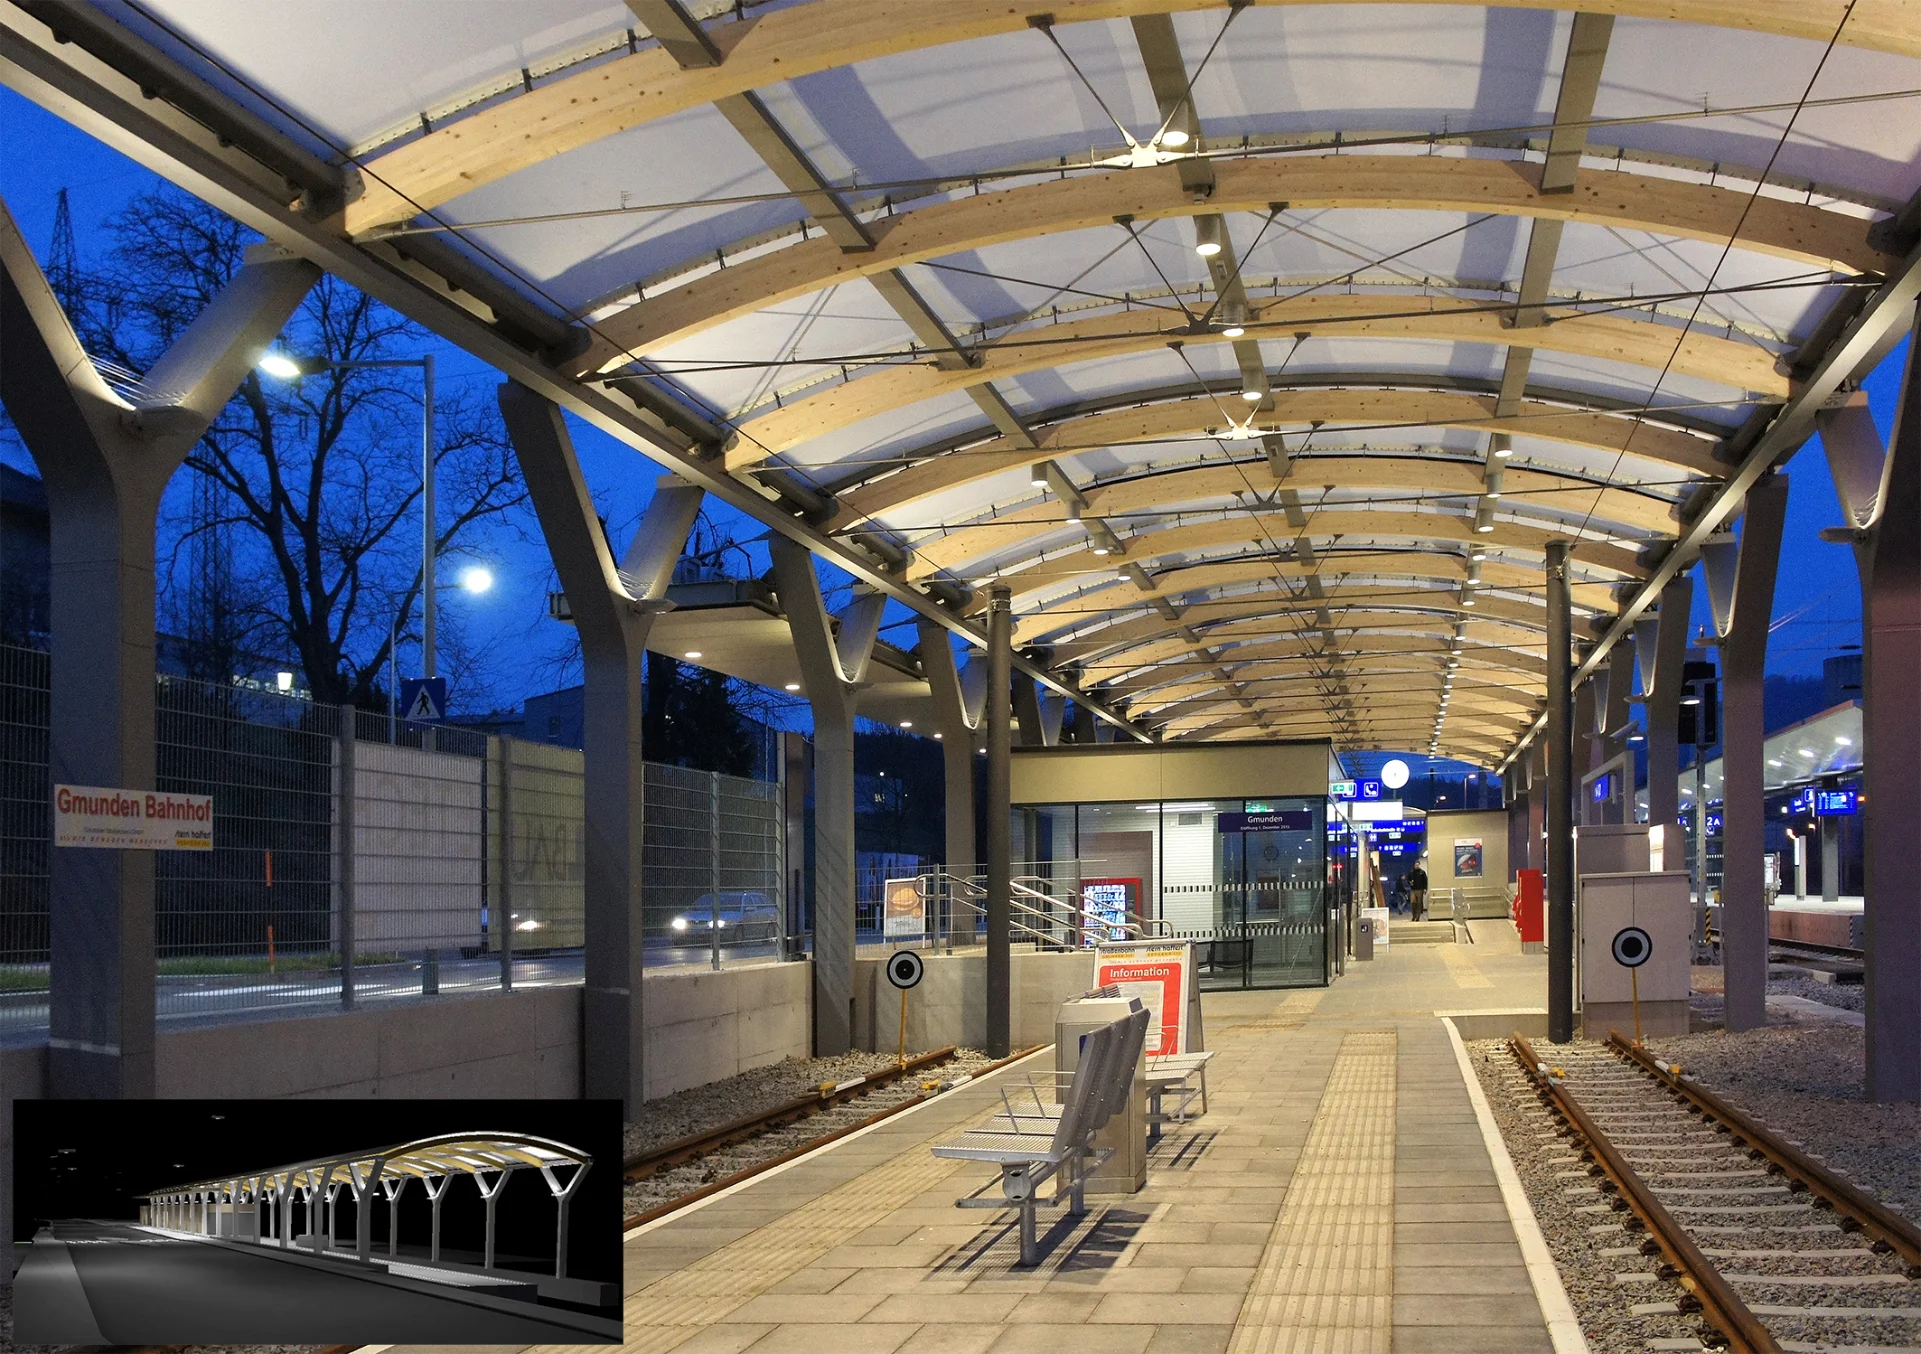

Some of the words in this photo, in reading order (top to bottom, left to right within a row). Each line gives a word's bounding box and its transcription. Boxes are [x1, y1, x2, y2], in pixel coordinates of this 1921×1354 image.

[57, 788, 140, 817] Gmunden
[145, 794, 211, 821] Bahnhof
[1110, 966, 1170, 977] Information
